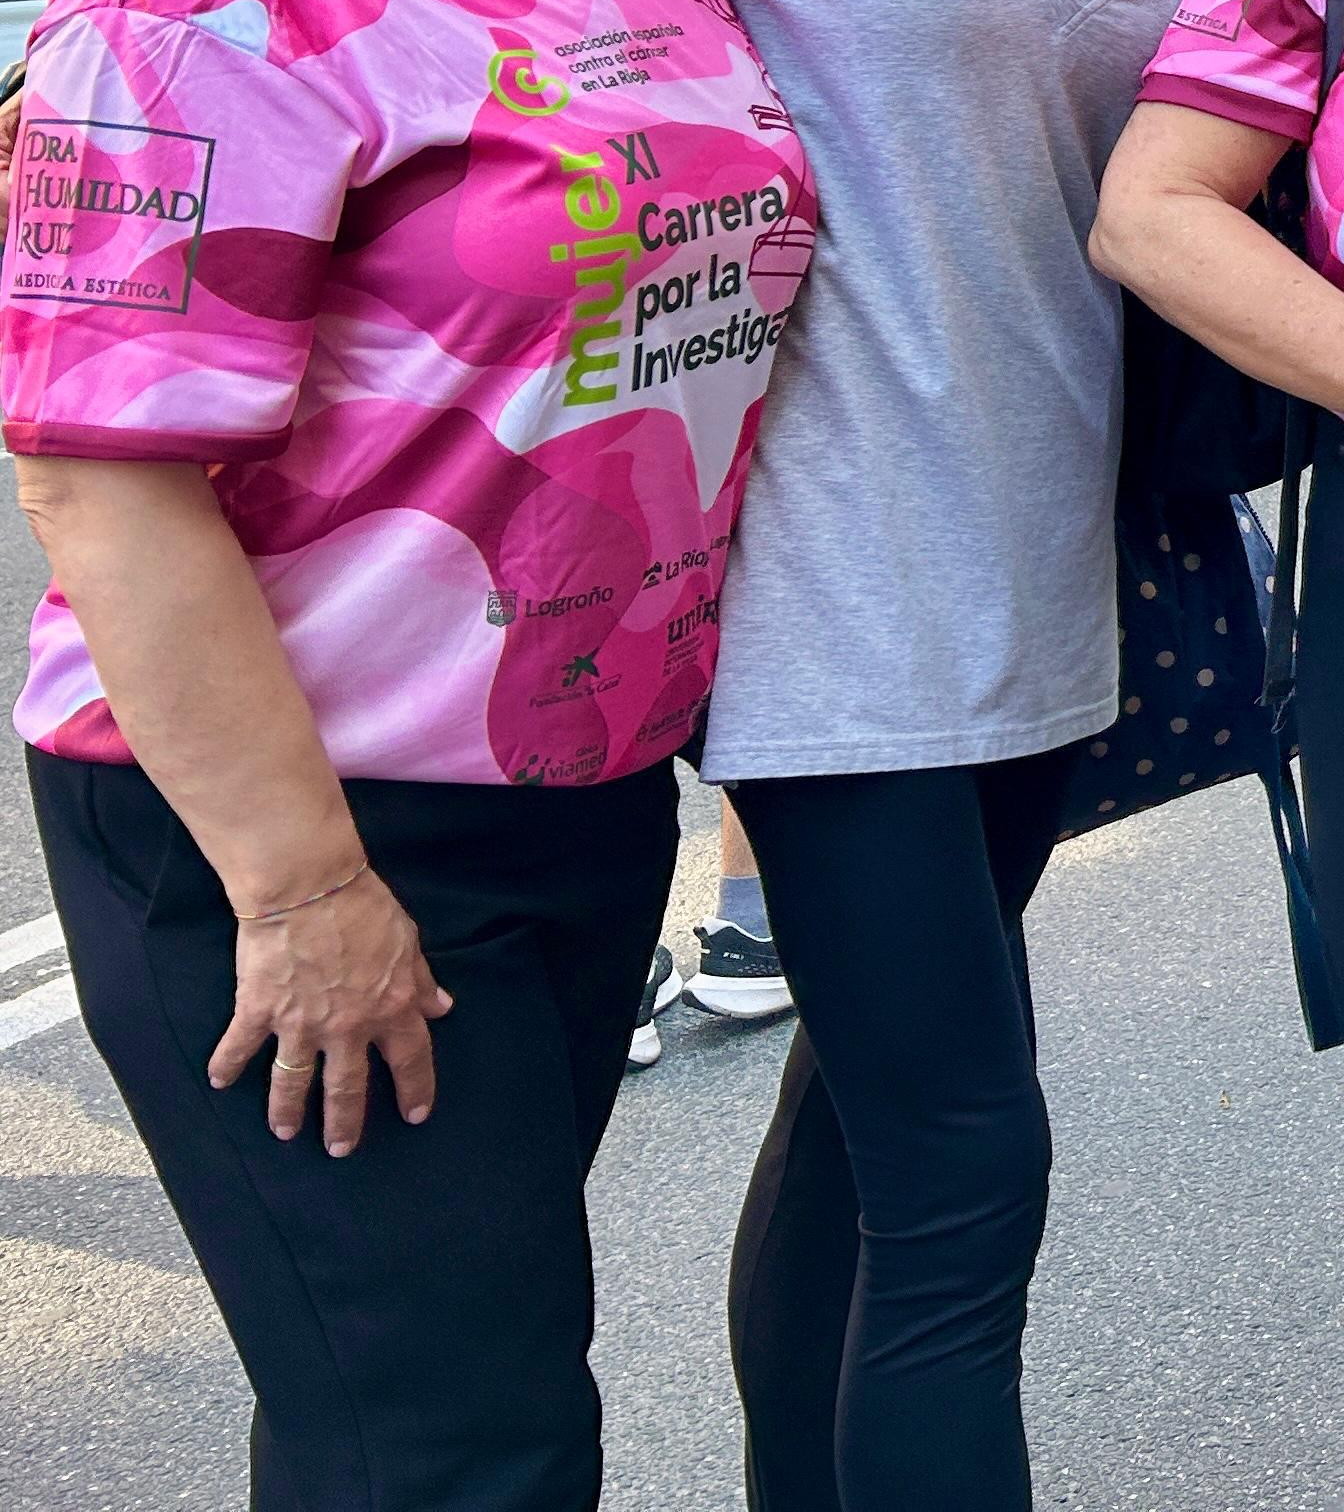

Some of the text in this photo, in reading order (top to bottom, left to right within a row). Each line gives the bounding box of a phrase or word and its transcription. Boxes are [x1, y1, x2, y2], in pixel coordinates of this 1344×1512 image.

[554, 30, 632, 57] asociación
[568, 49, 628, 74] contra el
[581, 68, 651, 92] en La Rioja
[26, 131, 78, 163] DRA
[606, 132, 661, 185] XI
[24, 169, 199, 222] HUMILDAD
[638, 186, 785, 252] Carrera
[83, 276, 171, 300] ESTÉTICA
[551, 152, 643, 407] mujer
[634, 254, 741, 337] por la
[631, 307, 791, 392] Investiga
[665, 561, 681, 581] La
[525, 586, 614, 617] Logroño
